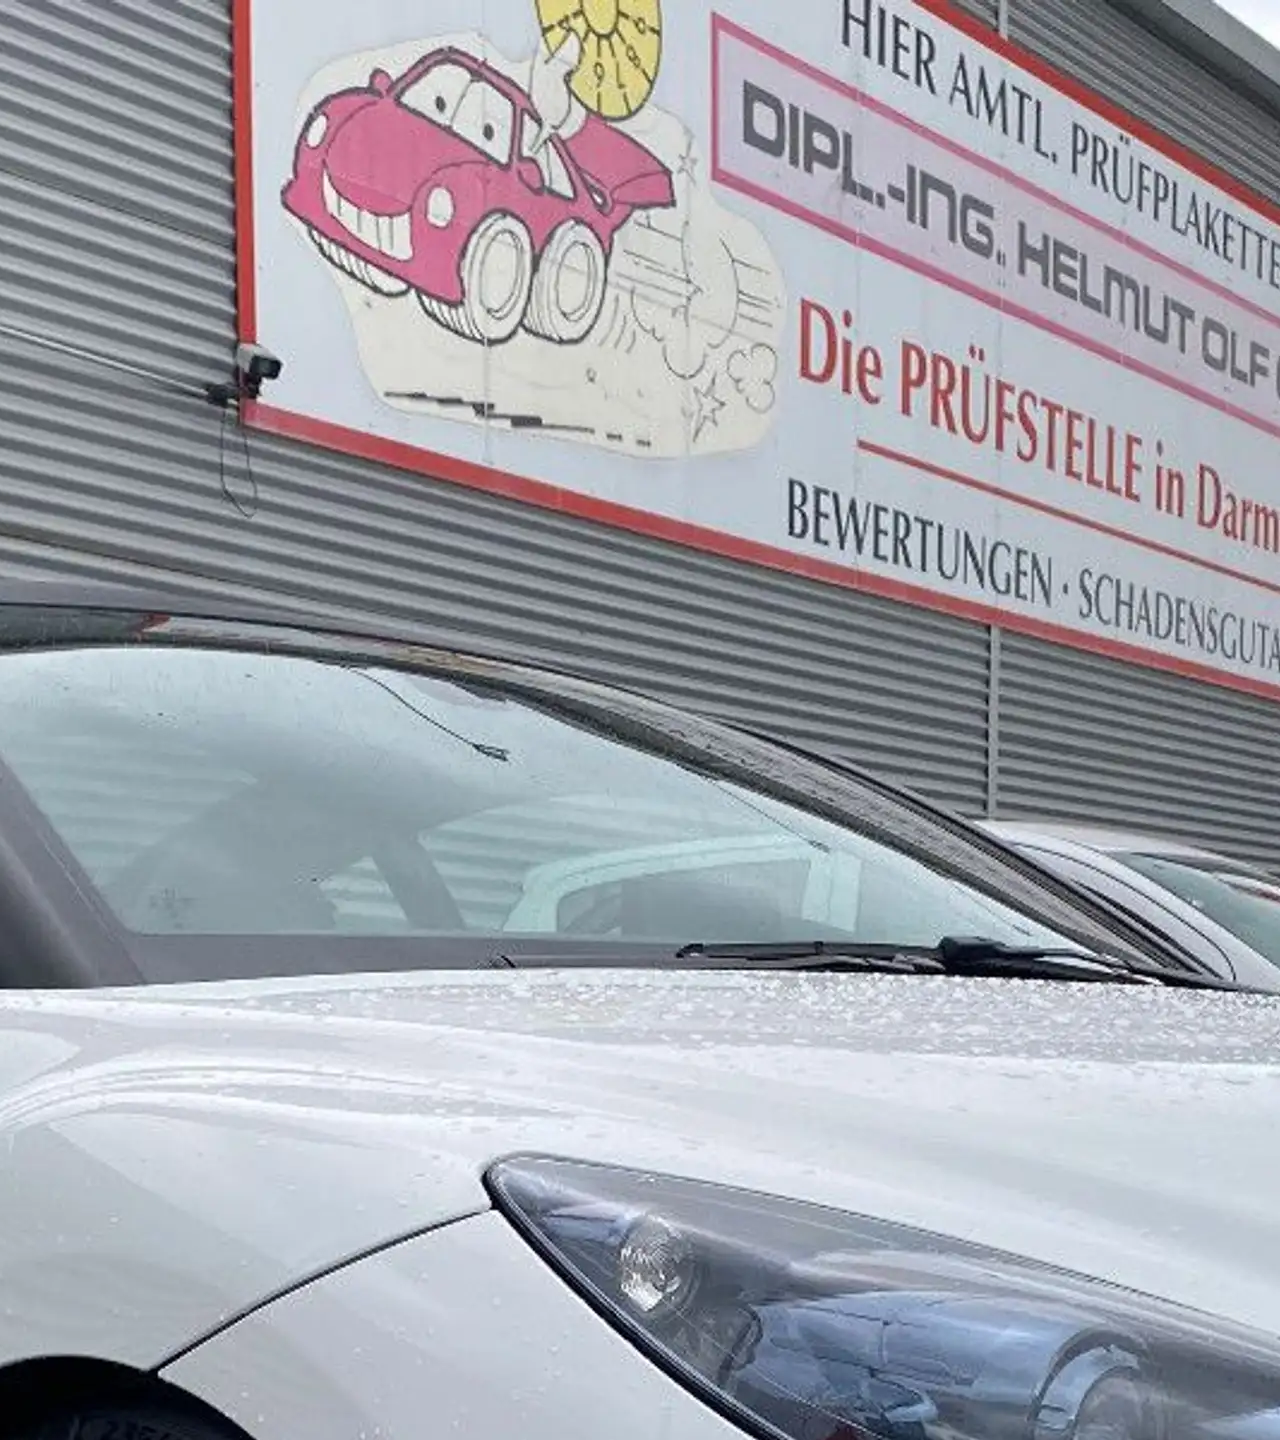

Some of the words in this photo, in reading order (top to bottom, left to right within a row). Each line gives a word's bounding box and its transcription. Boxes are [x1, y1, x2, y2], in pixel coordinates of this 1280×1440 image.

[841, 0, 937, 95] HIER
[949, 52, 1059, 165] AMTL.
[1017, 219, 1196, 354] HELMUT
[1201, 319, 1269, 388] OLF
[799, 298, 882, 405] Die
[900, 340, 1142, 504] PRÜFSTELLE
[1154, 439, 1186, 519] in
[787, 477, 1053, 609] BEWERTUNGEN
